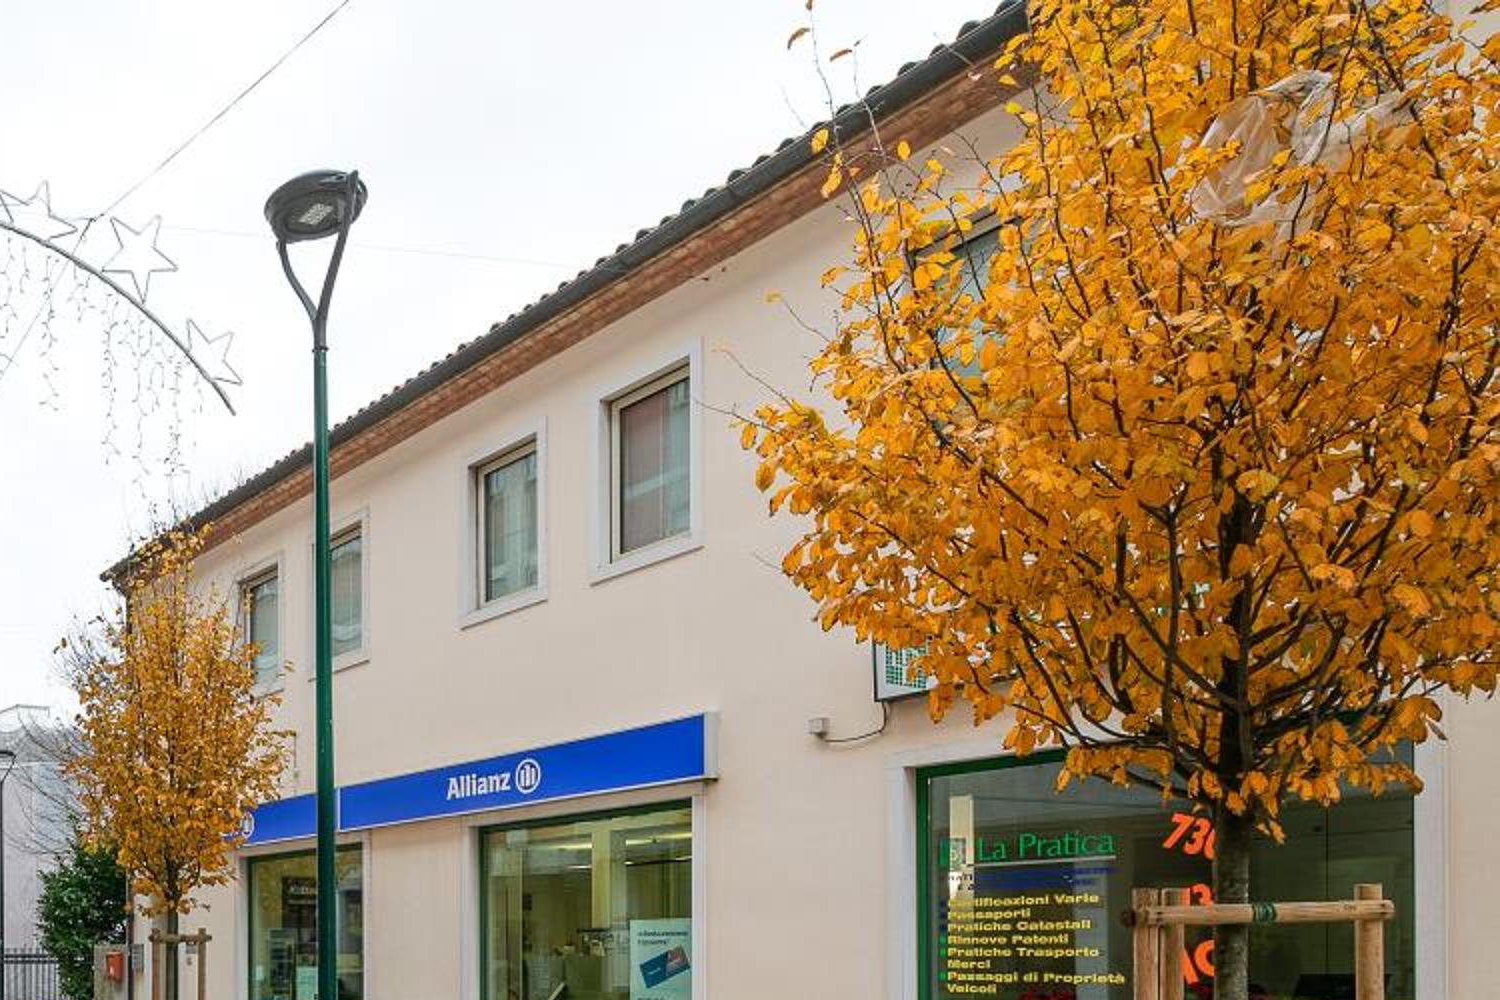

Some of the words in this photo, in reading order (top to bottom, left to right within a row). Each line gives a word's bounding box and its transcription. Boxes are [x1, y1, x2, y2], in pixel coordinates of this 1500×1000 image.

[446, 772, 511, 800] Allianz
[978, 838, 1008, 861] La
[1018, 830, 1115, 858] Pratica
[1055, 893, 1100, 905] Varie
[947, 908, 1032, 921] Passaporti
[947, 921, 1012, 932] Pratiche
[1016, 919, 1092, 931] Catastali
[947, 934, 1008, 945] Rinnovo
[1012, 933, 1070, 945] Patenti
[947, 947, 1013, 958] Pratiche
[1016, 947, 1100, 960] Trasporto
[947, 959, 992, 970] Merci
[947, 971, 1019, 984] Passaggi
[1023, 971, 1039, 982] di
[1044, 972, 1126, 986] Proprietà
[947, 983, 998, 994] Veicoli
